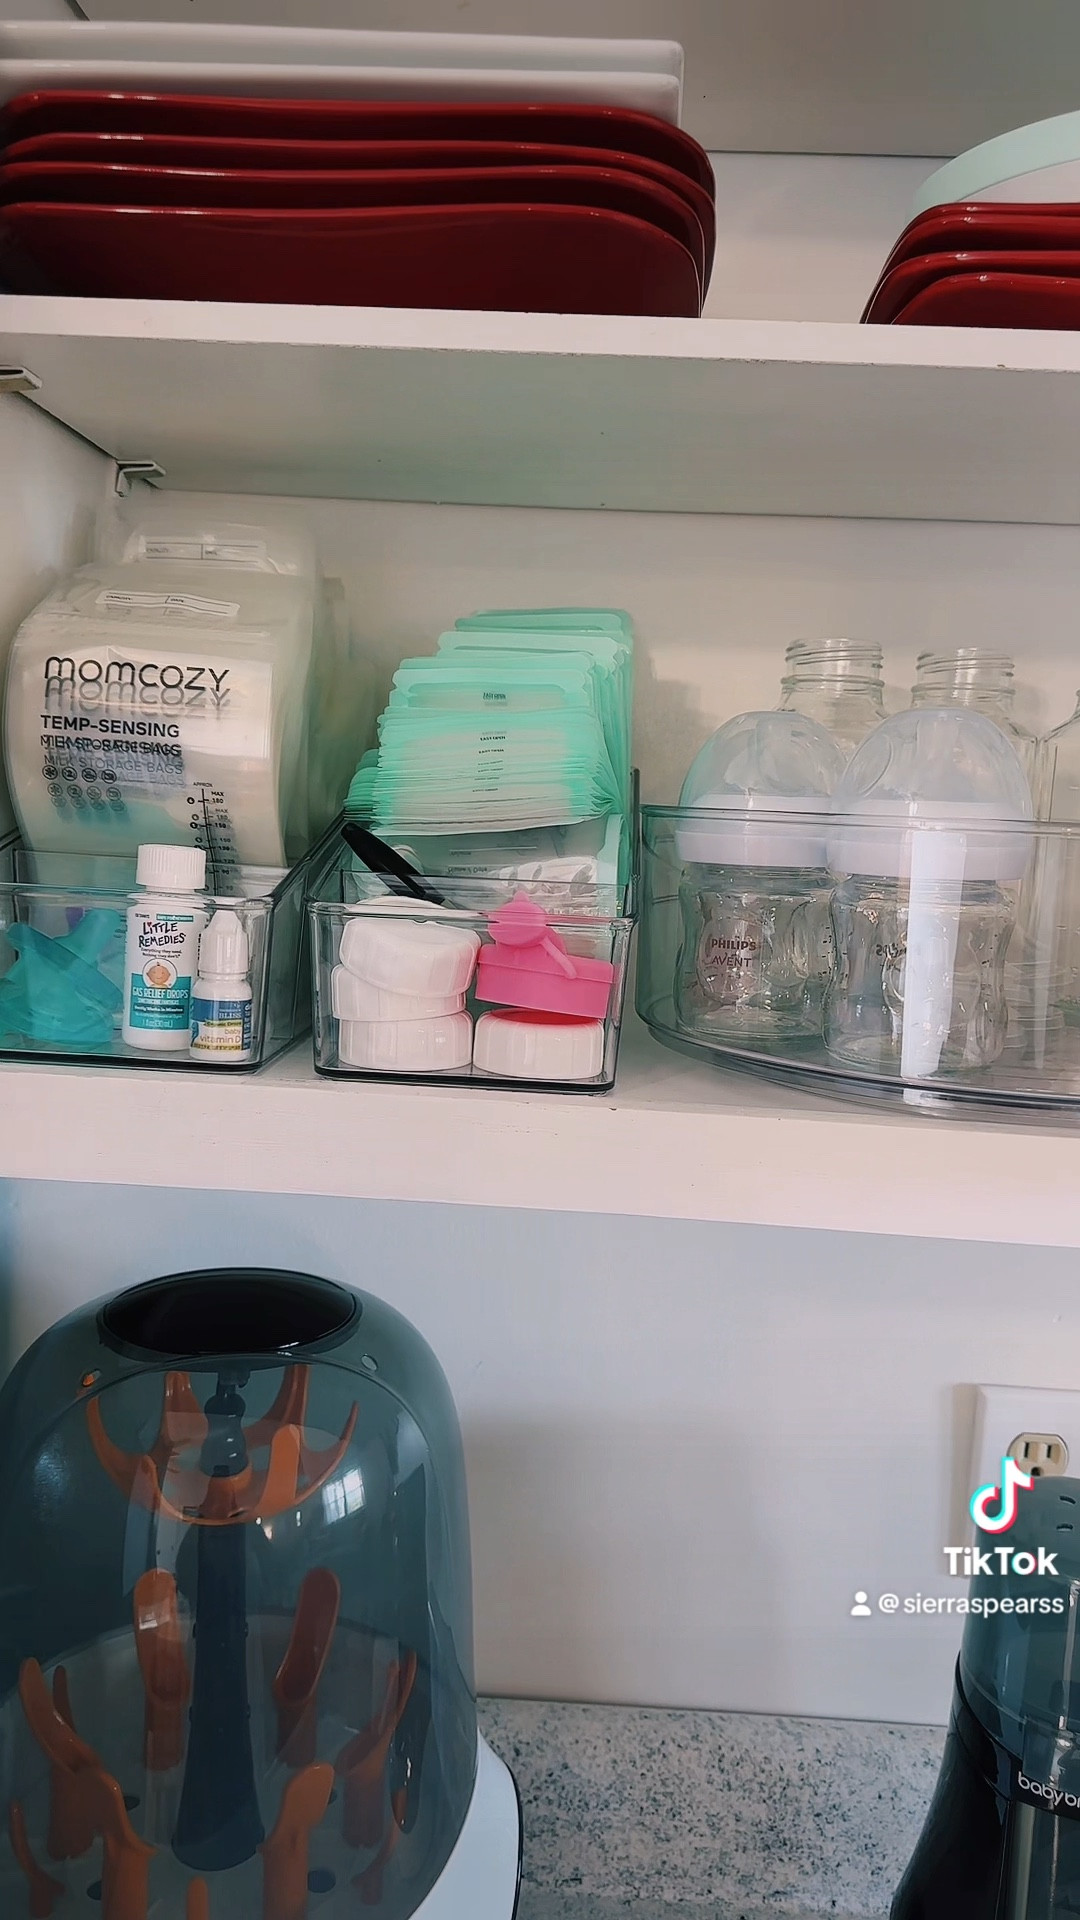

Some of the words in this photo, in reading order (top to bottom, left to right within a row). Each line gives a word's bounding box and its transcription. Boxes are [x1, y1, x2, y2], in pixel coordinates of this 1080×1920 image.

[40, 715, 180, 738] TEMP-SENSING
[139, 932, 187, 948] REMEDIES
[711, 938, 757, 951] PHILIPS
[711, 954, 752, 967] AVENT
[167, 989, 189, 999] DROPS
